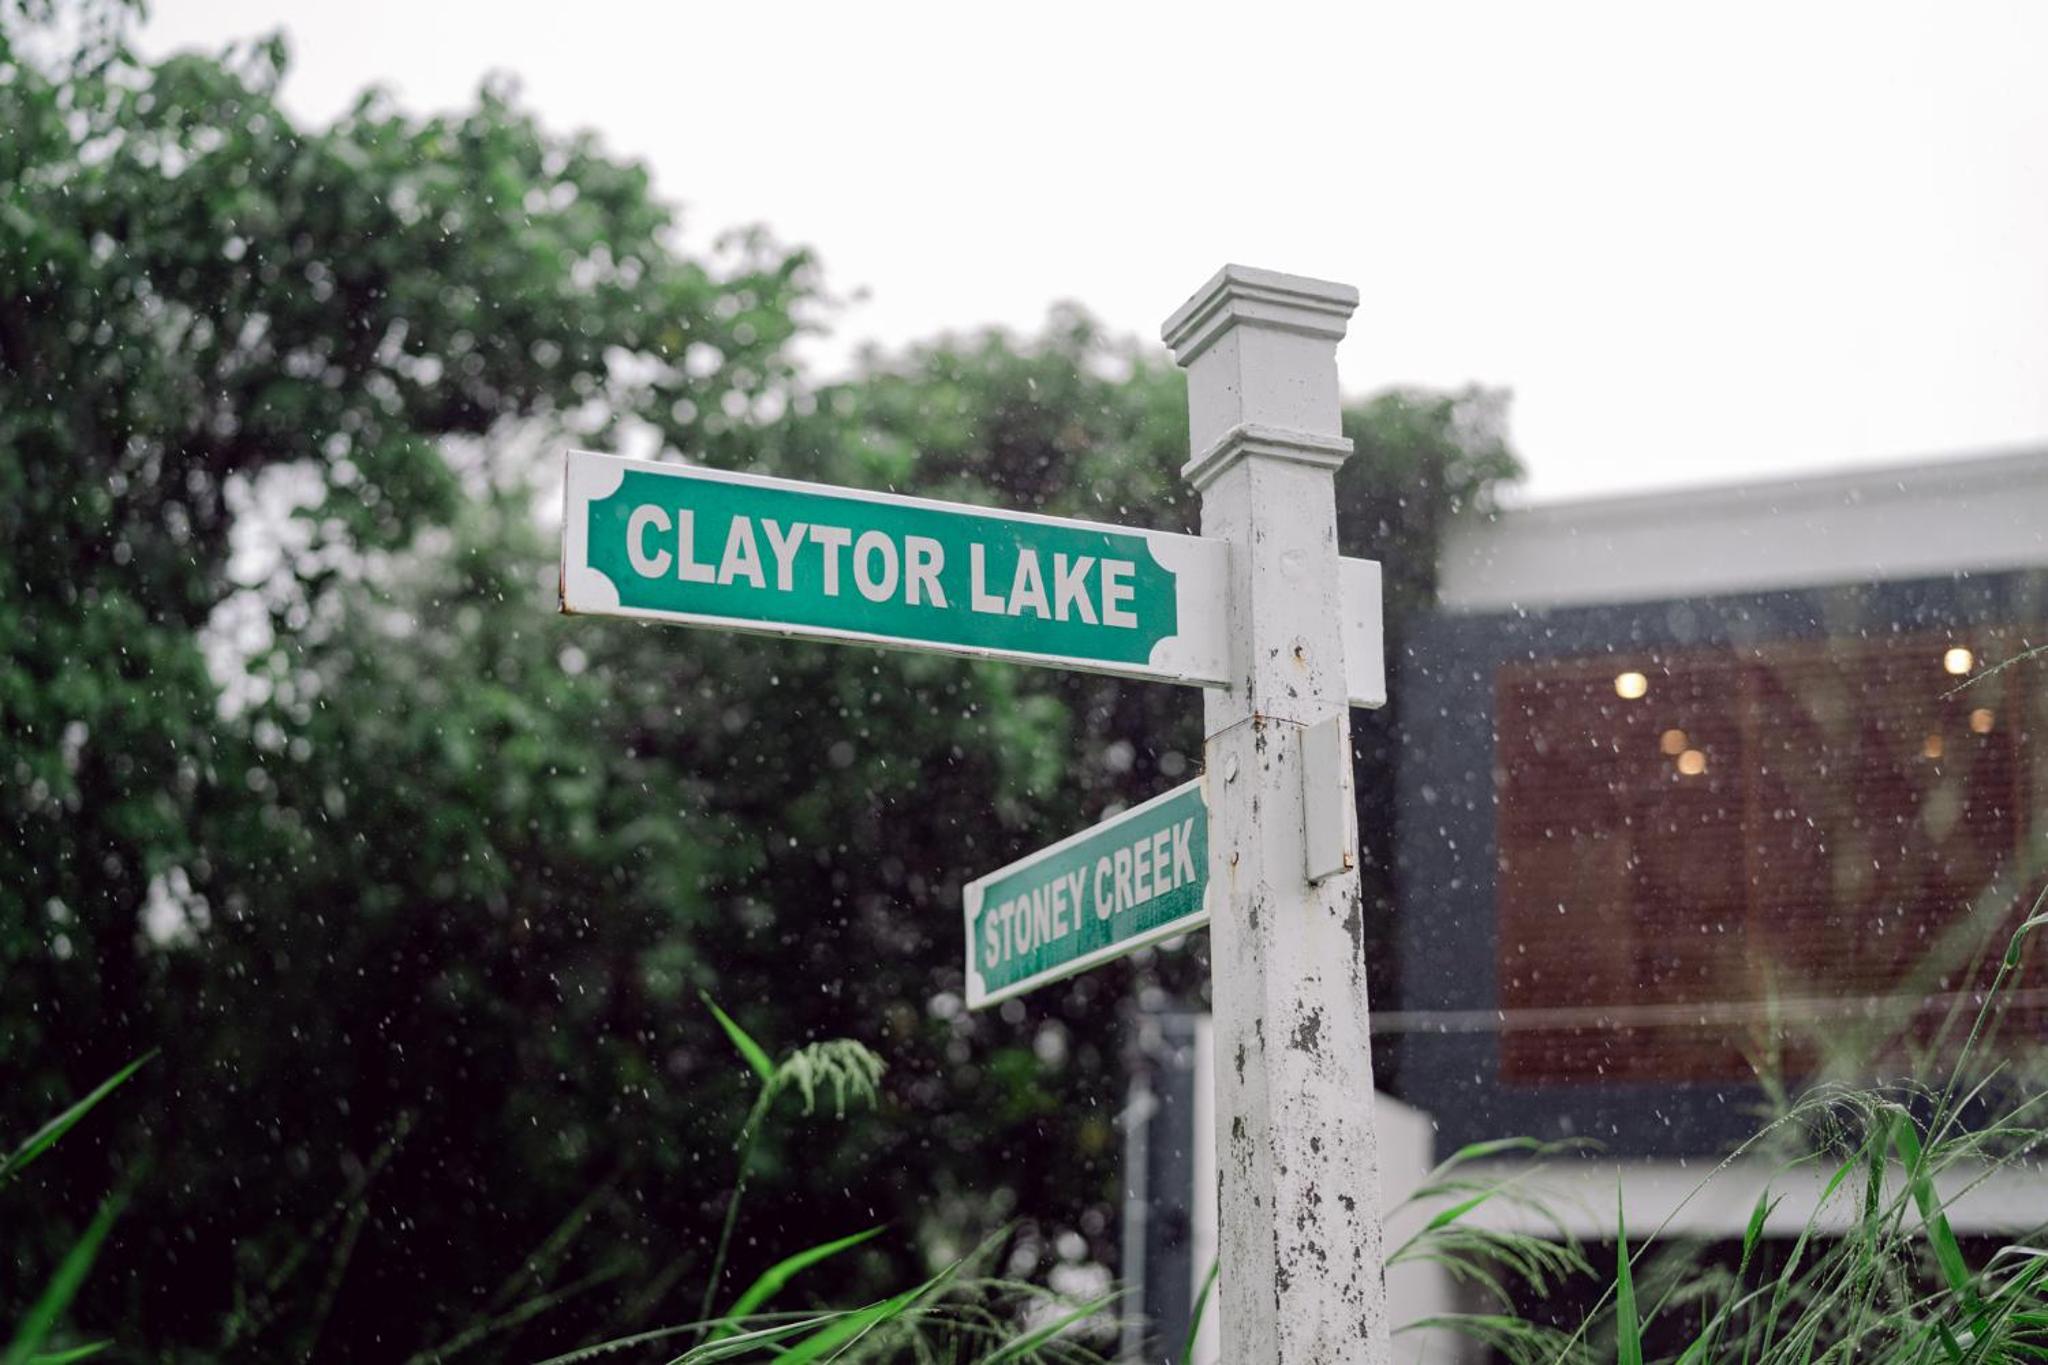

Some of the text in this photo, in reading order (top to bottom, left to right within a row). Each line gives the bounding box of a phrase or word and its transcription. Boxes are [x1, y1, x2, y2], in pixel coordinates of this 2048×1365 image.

[626, 504, 1138, 629] CLAYTOR LAKE
[985, 817, 1196, 969] STONEY CREEK
